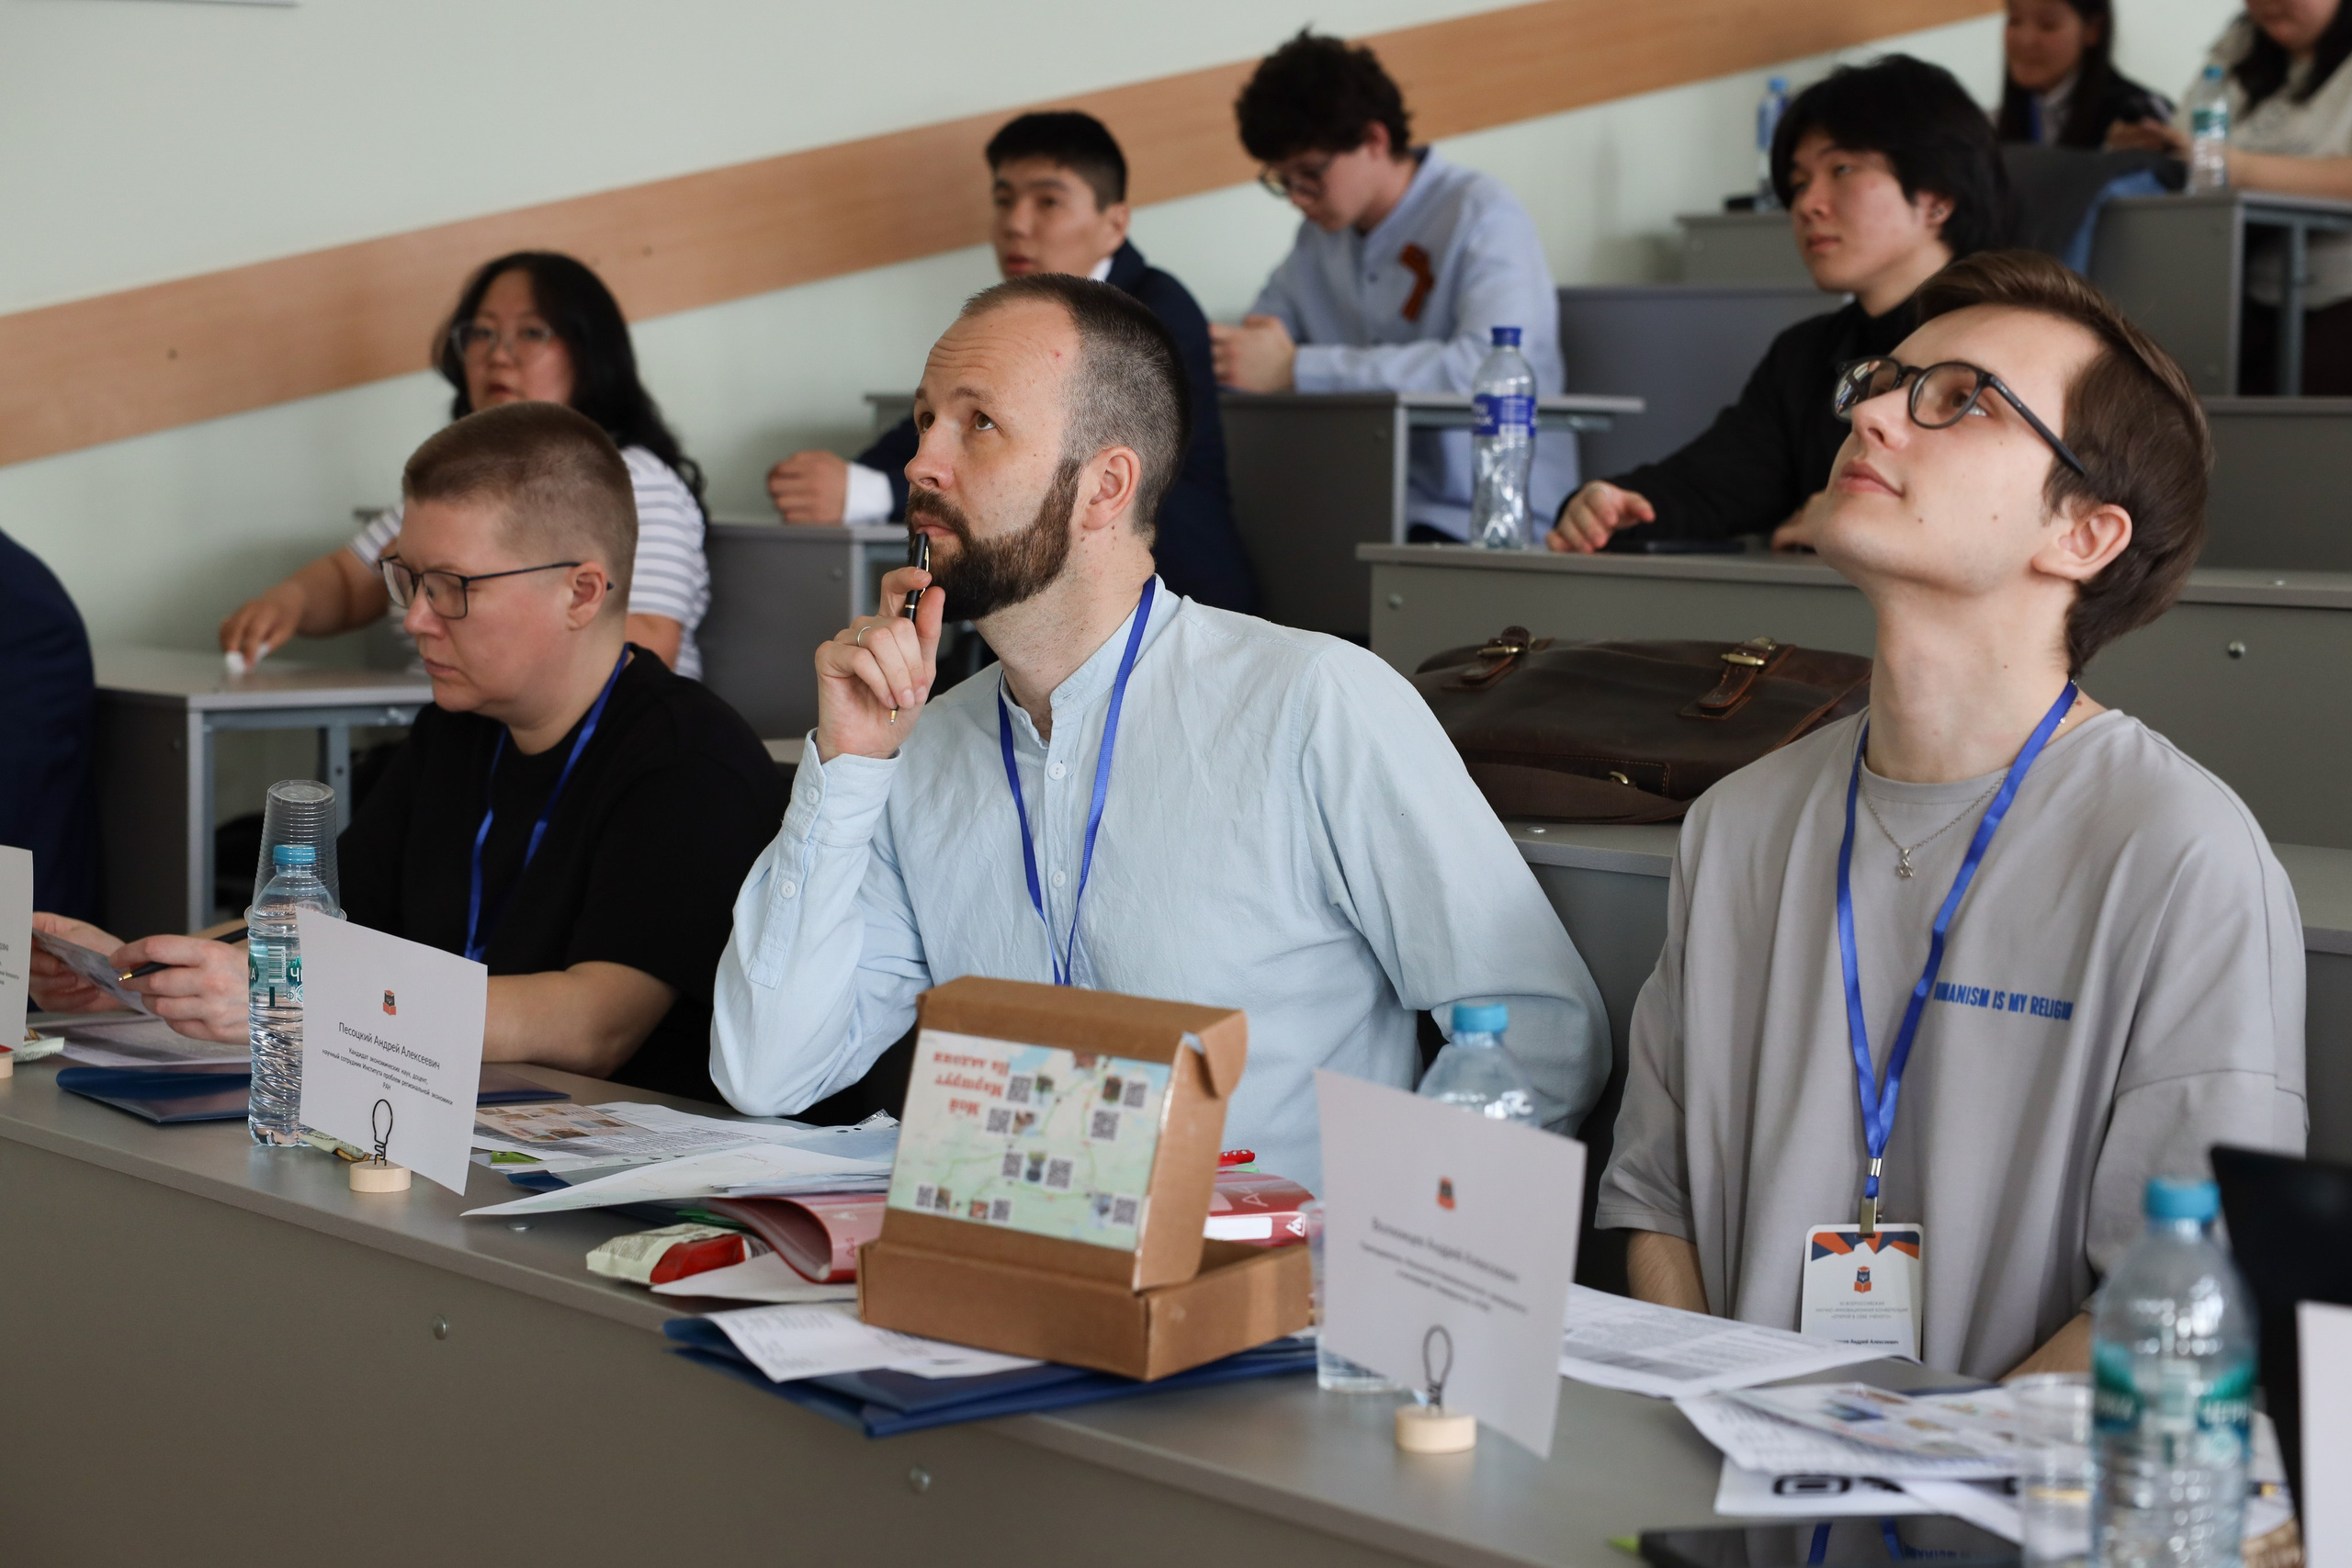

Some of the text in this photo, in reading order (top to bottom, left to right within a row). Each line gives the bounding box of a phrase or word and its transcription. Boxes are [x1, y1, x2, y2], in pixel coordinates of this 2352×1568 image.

[1933, 981, 1990, 1008] UMANISM
[1993, 990, 2006, 1010] IS
[2008, 992, 2028, 1013] MY
[338, 1021, 440, 1070] Песоцкий Андрей Алексеевич
[349, 1047, 368, 1060] Кандидат
[369, 1056, 400, 1073] экономических
[322, 1049, 453, 1105] научный сотрудник Института проблем региональной экономики
